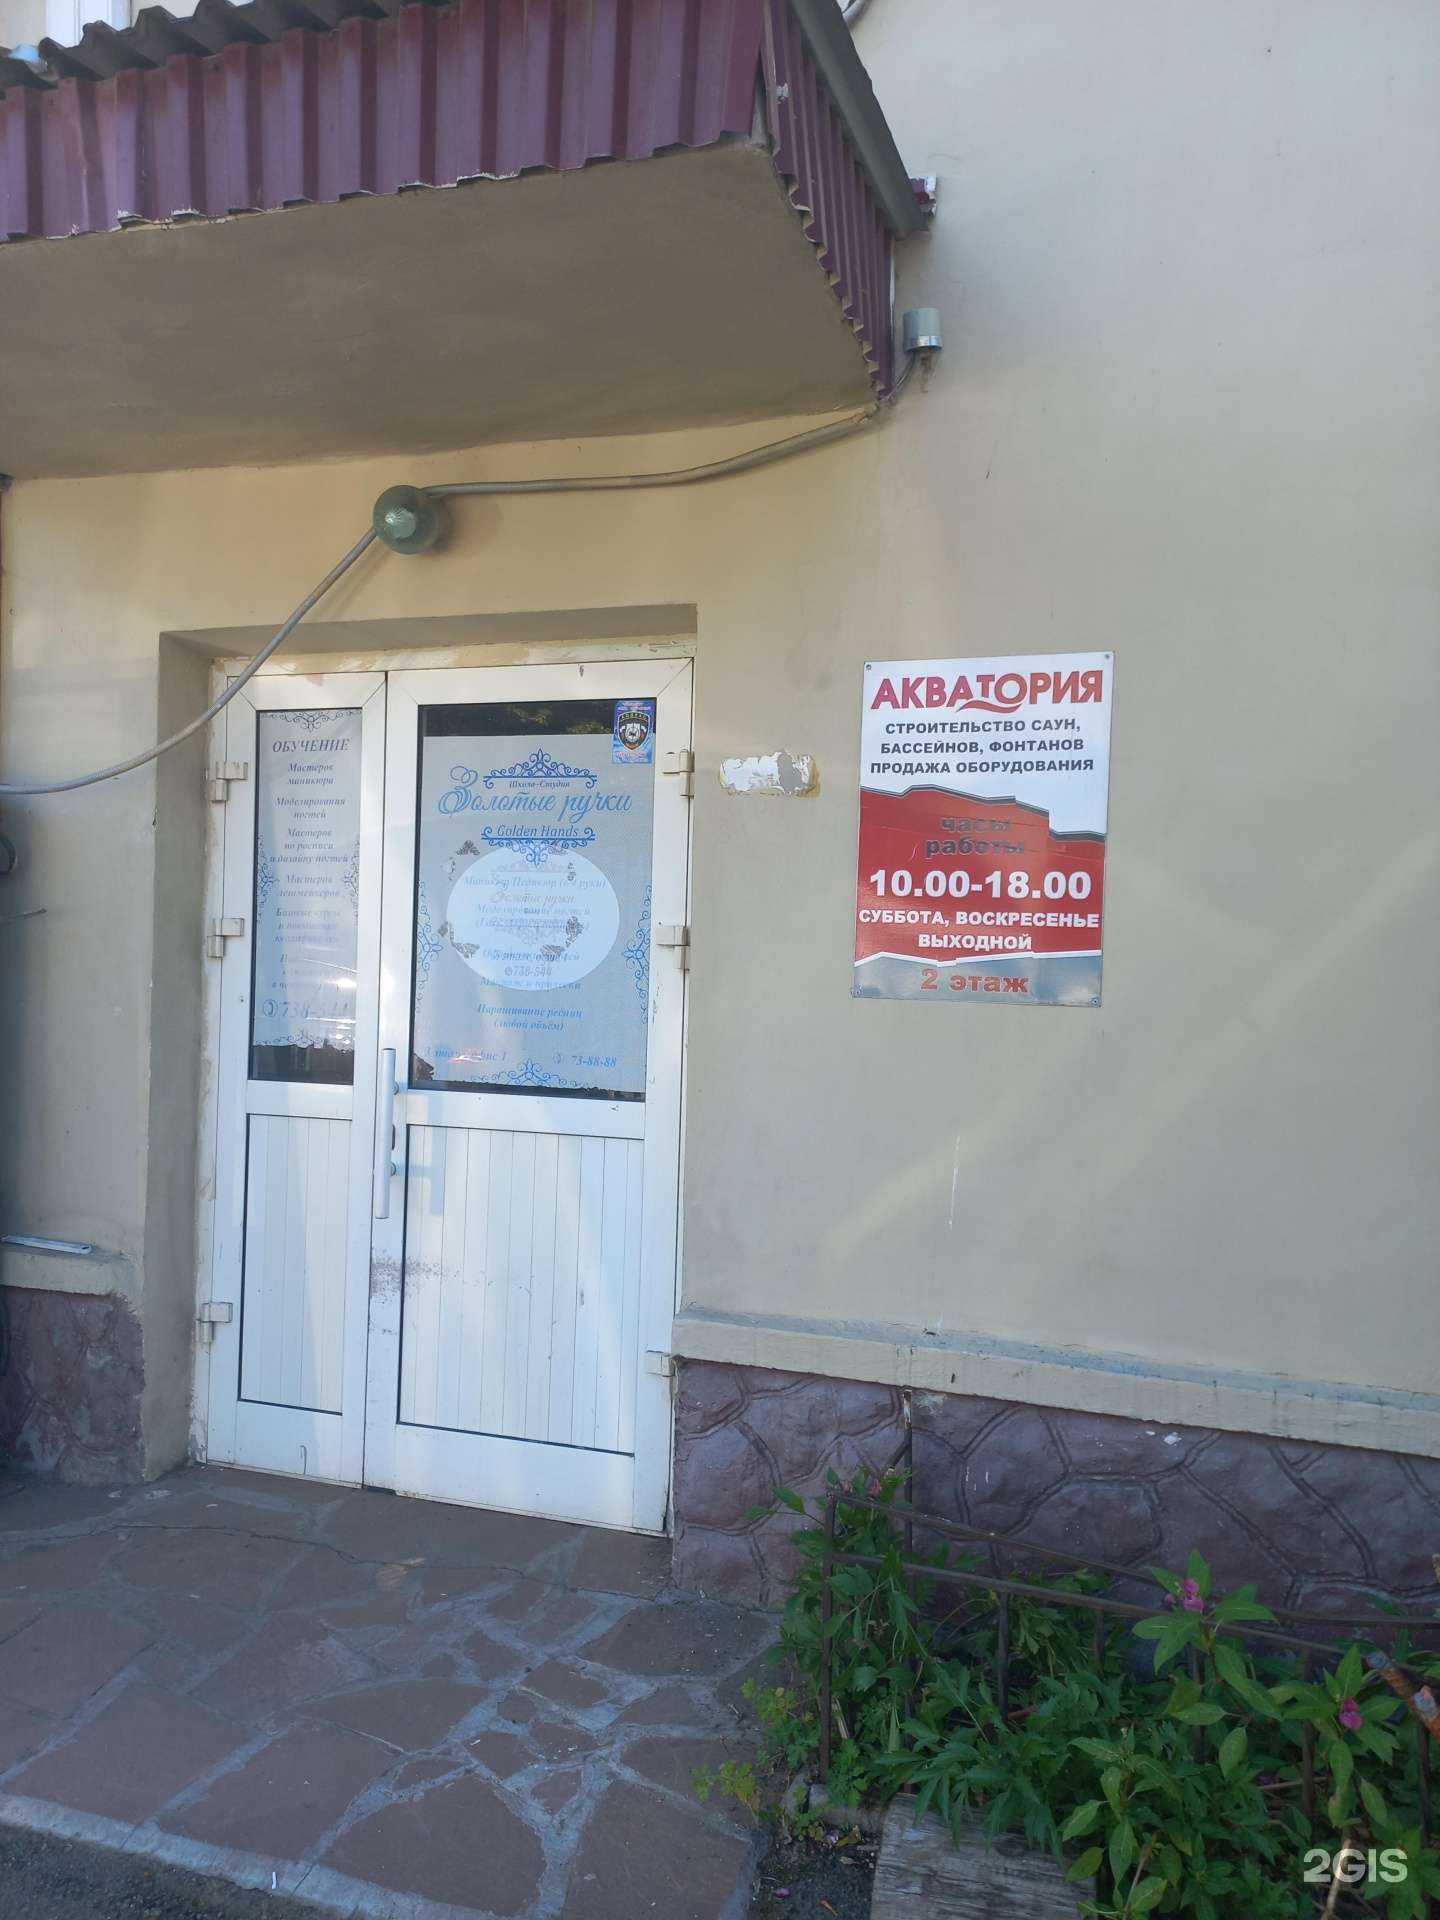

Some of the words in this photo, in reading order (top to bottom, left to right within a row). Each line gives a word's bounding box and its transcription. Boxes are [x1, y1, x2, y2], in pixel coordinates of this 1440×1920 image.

[870, 669, 1103, 711] АКВАТОРИЯ
[885, 720, 1026, 735] СТРОИТЕЛЬСТВО
[1031, 718, 1081, 732] САУН,
[272, 738, 350, 753] ОБУЧЕНИЕ
[880, 740, 984, 755] БАССЕЙНОВ,
[989, 738, 1085, 753] ФОНТАНОВ
[870, 761, 951, 775] ПРОДАЖА
[956, 759, 1094, 775] ОБОРУДОВАНИЯ
[437, 765, 557, 818] Золотые
[557, 789, 632, 823] ручки
[497, 825, 538, 838] Golden
[539, 825, 579, 838] Hands
[939, 817, 1013, 834] часы
[925, 837, 1026, 859] работы
[869, 869, 1092, 900] 10.00-18.00
[858, 909, 950, 927] СУББОТА,
[956, 911, 1100, 928] ВОСКРЕСЕНЬЕ
[918, 933, 1033, 952] ВЫХОДНОЙ
[920, 968, 939, 990] 2
[949, 974, 1030, 993] этаж
